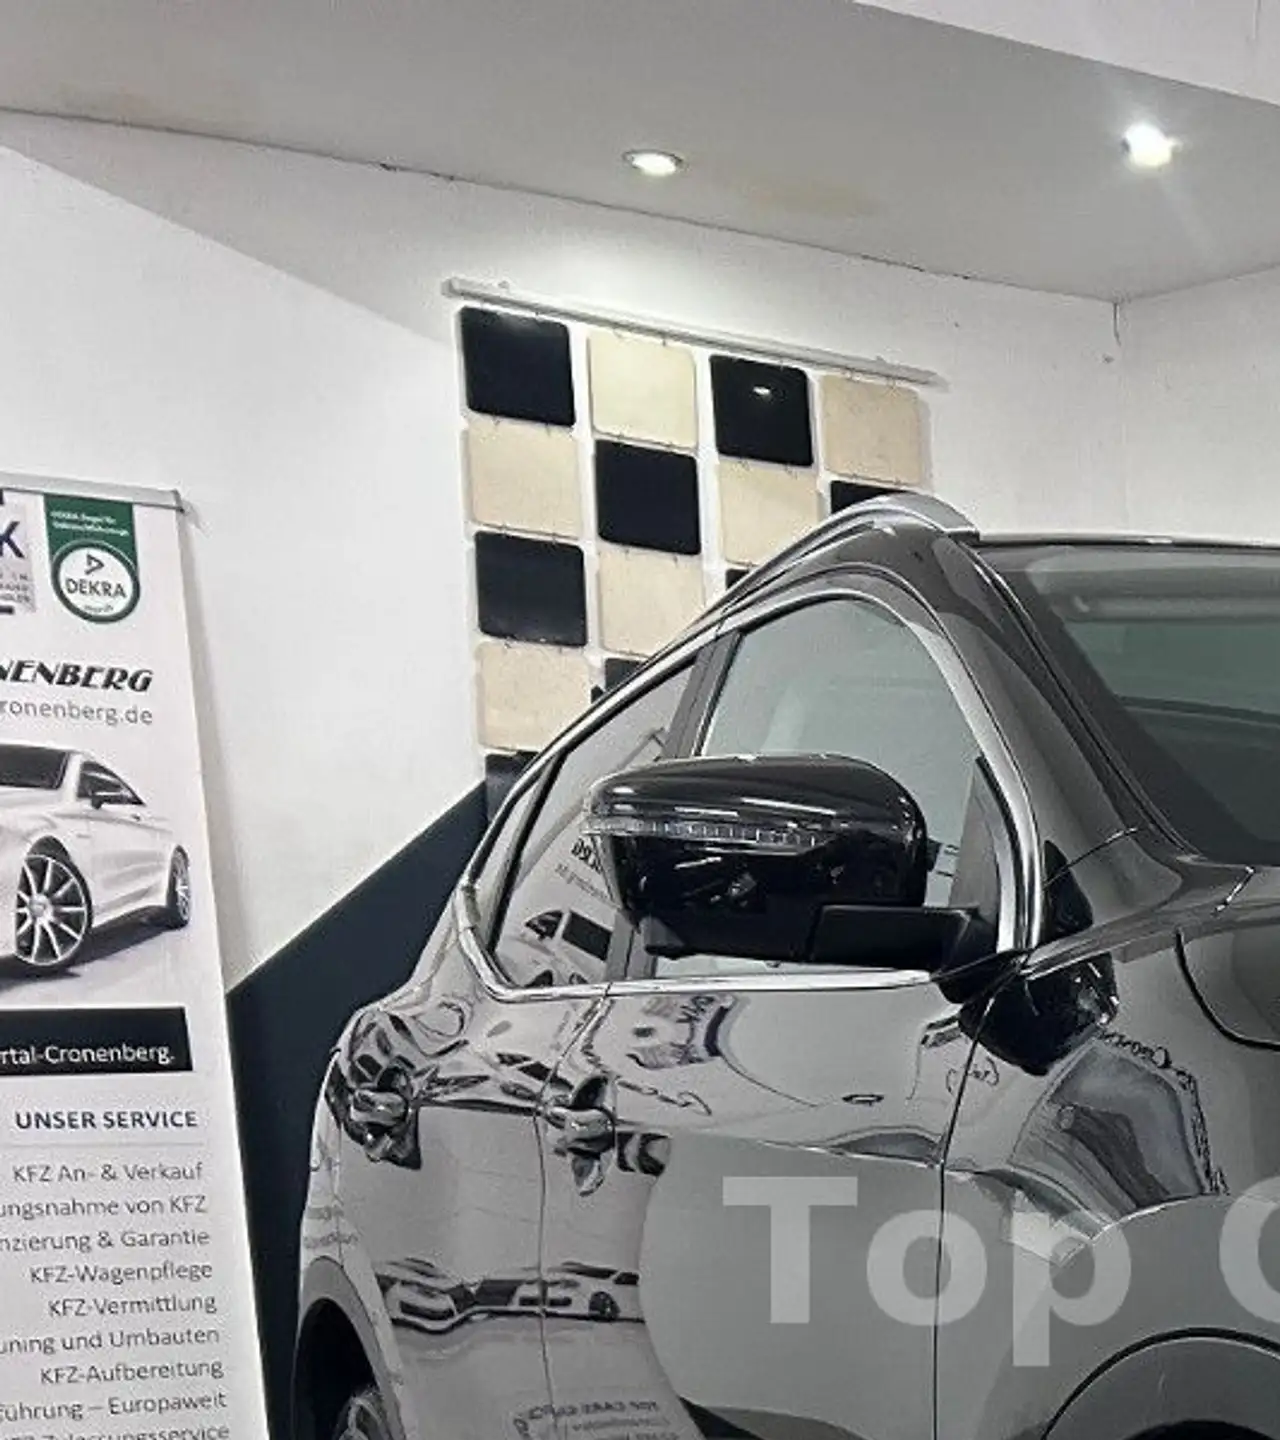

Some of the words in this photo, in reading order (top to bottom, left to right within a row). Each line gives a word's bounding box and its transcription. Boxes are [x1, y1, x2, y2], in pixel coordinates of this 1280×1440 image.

[65, 578, 127, 599] DEKRA
[15, 1111, 97, 1129] UNSER
[103, 1111, 198, 1129] SERVICE
[12, 1164, 51, 1182] KFZ
[57, 1164, 96, 1182] An-
[100, 1163, 117, 1181] &
[123, 1161, 203, 1180] Verkauf
[125, 1199, 164, 1214] von
[168, 1194, 208, 1214] KFZ
[98, 1230, 114, 1249] &
[121, 1229, 211, 1247] Garantie
[29, 1260, 213, 1285] KFZ-Wagenpflege
[48, 1294, 218, 1318] KFZ-Vermittlung
[61, 1330, 102, 1350] und
[109, 1328, 220, 1348] Umbauten
[40, 1361, 225, 1385] KFZ-Aufbereitung
[108, 1391, 228, 1416] Europaweit
